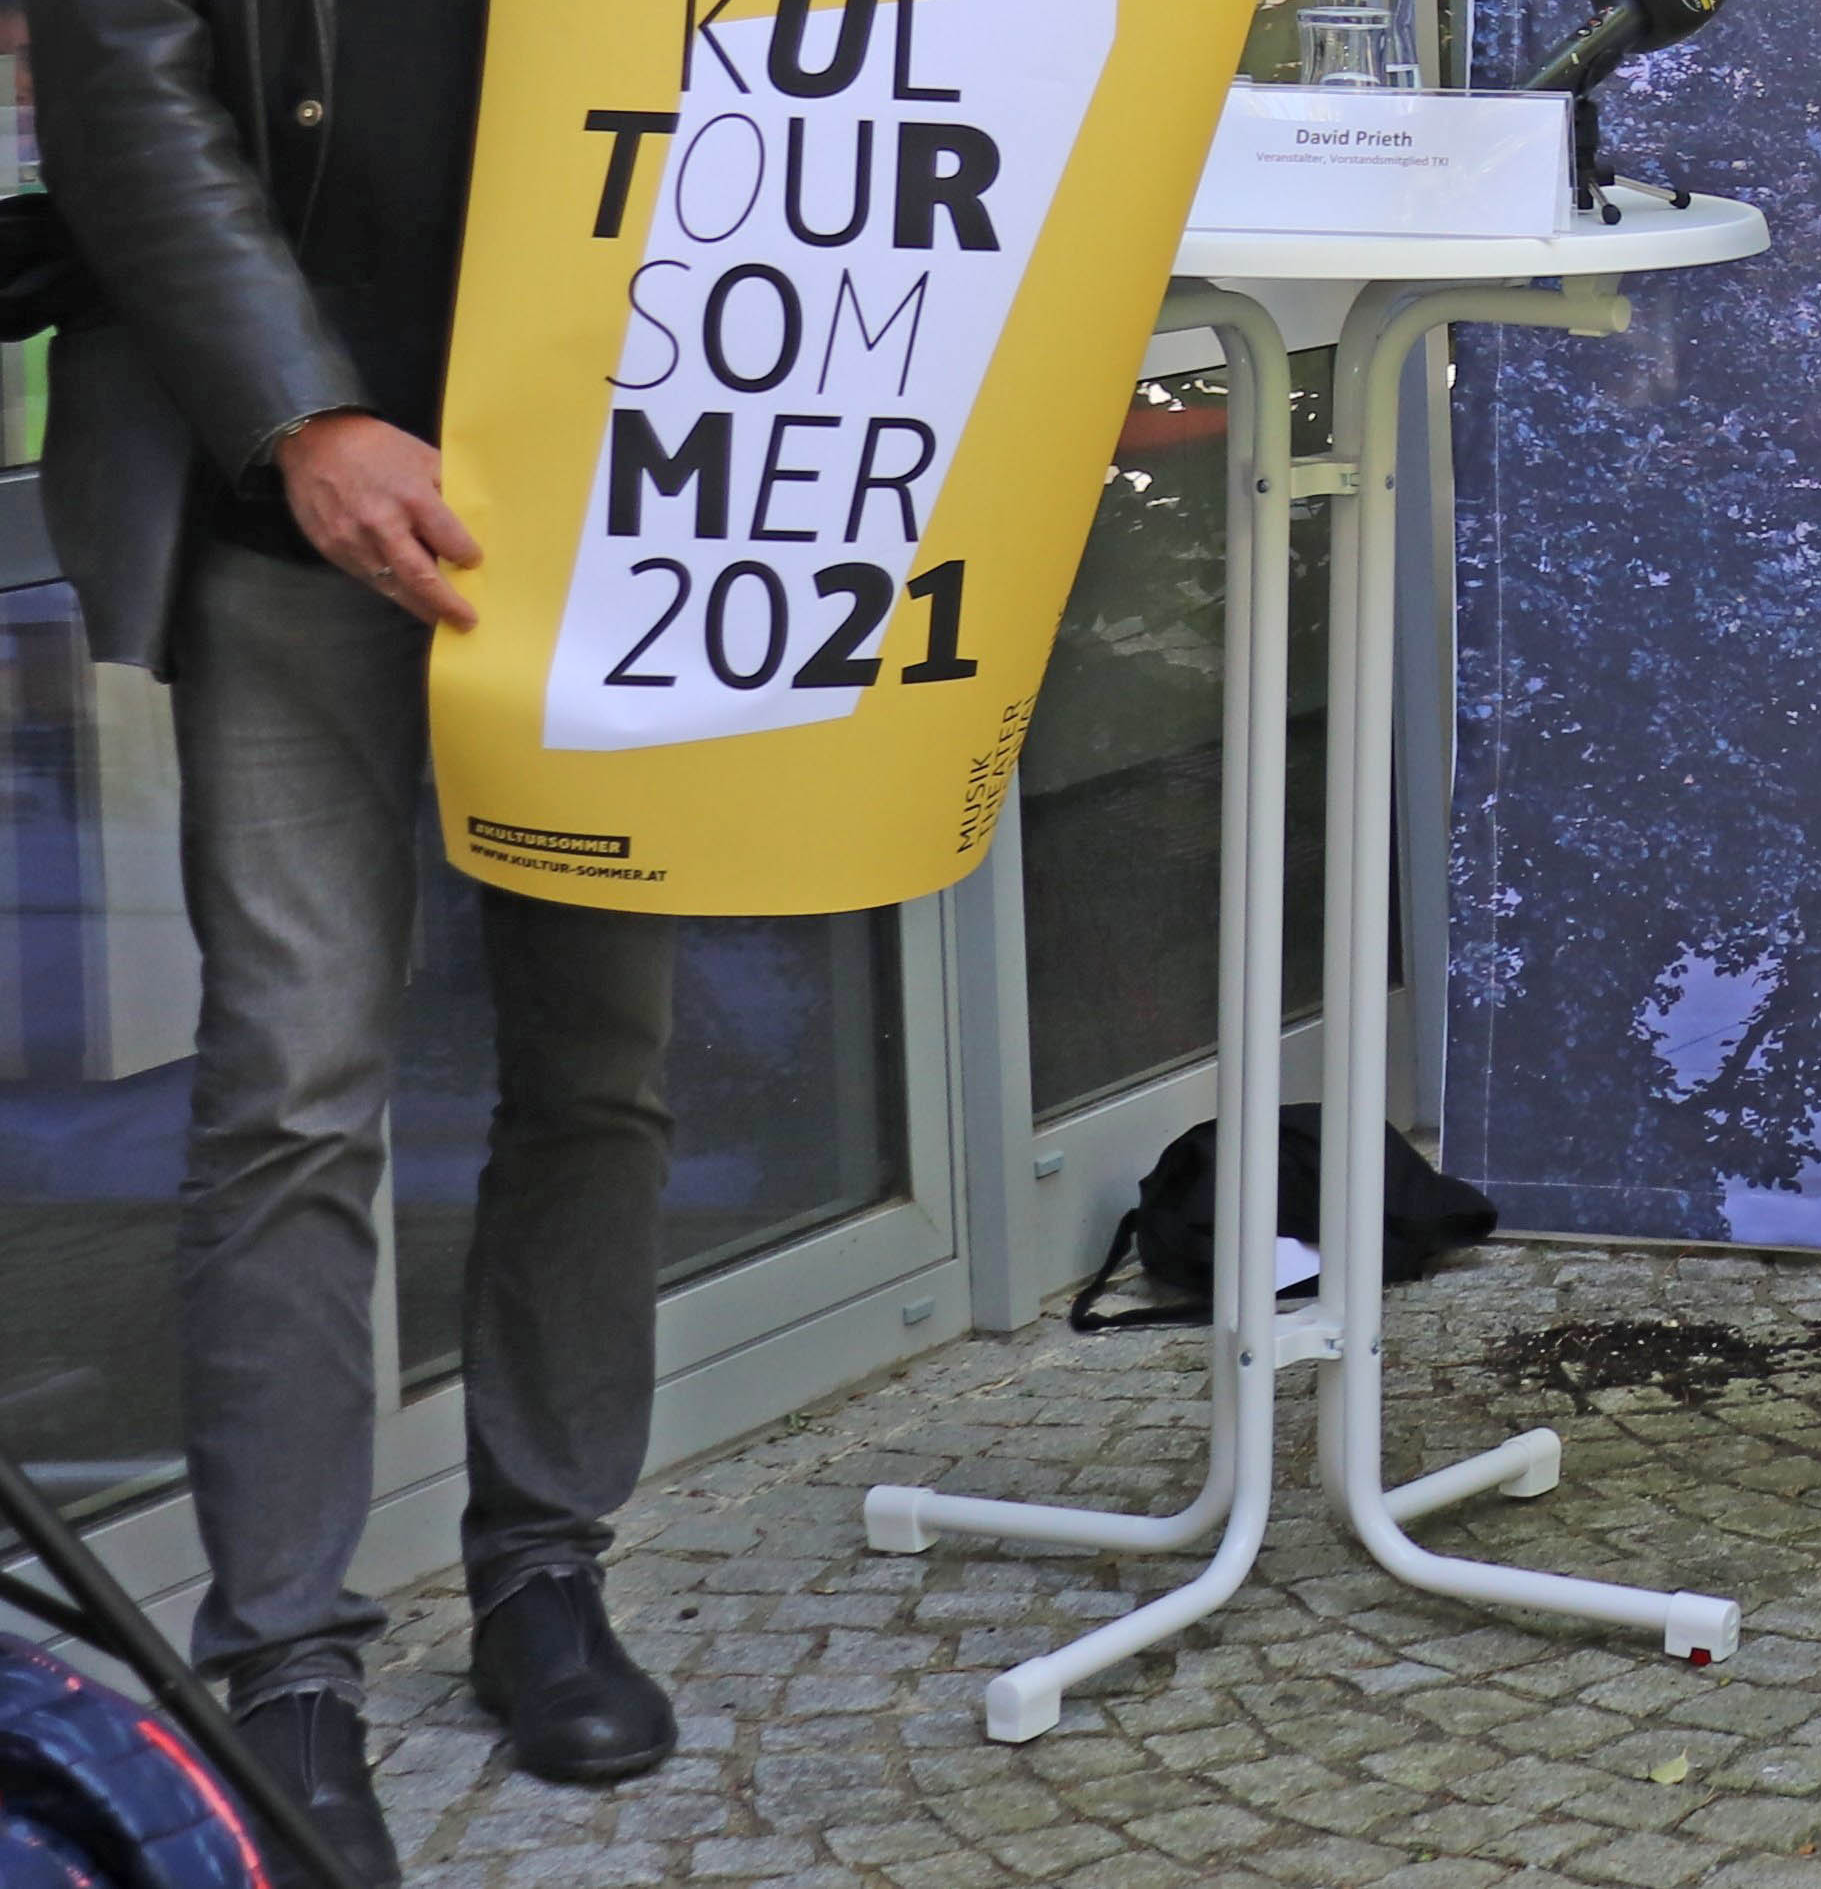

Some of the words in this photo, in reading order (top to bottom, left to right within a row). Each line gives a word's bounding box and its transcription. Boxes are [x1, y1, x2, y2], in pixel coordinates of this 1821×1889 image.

[584, 110, 999, 251] TOUR
[1255, 150, 1327, 165] Veranstalter,
[1329, 152, 1430, 169] Vorstandsmitglied
[1430, 155, 1450, 167] TKI
[1295, 128, 1350, 147] David
[1355, 130, 1414, 149] Prieth
[605, 260, 930, 398] SOM
[606, 408, 938, 543] MER
[604, 557, 978, 690] 2021
[474, 822, 622, 855] #KULTURSOMMER
[956, 750, 993, 853] MUSIK
[468, 842, 667, 882] WWW.KULTUR-SOMMER.AT
